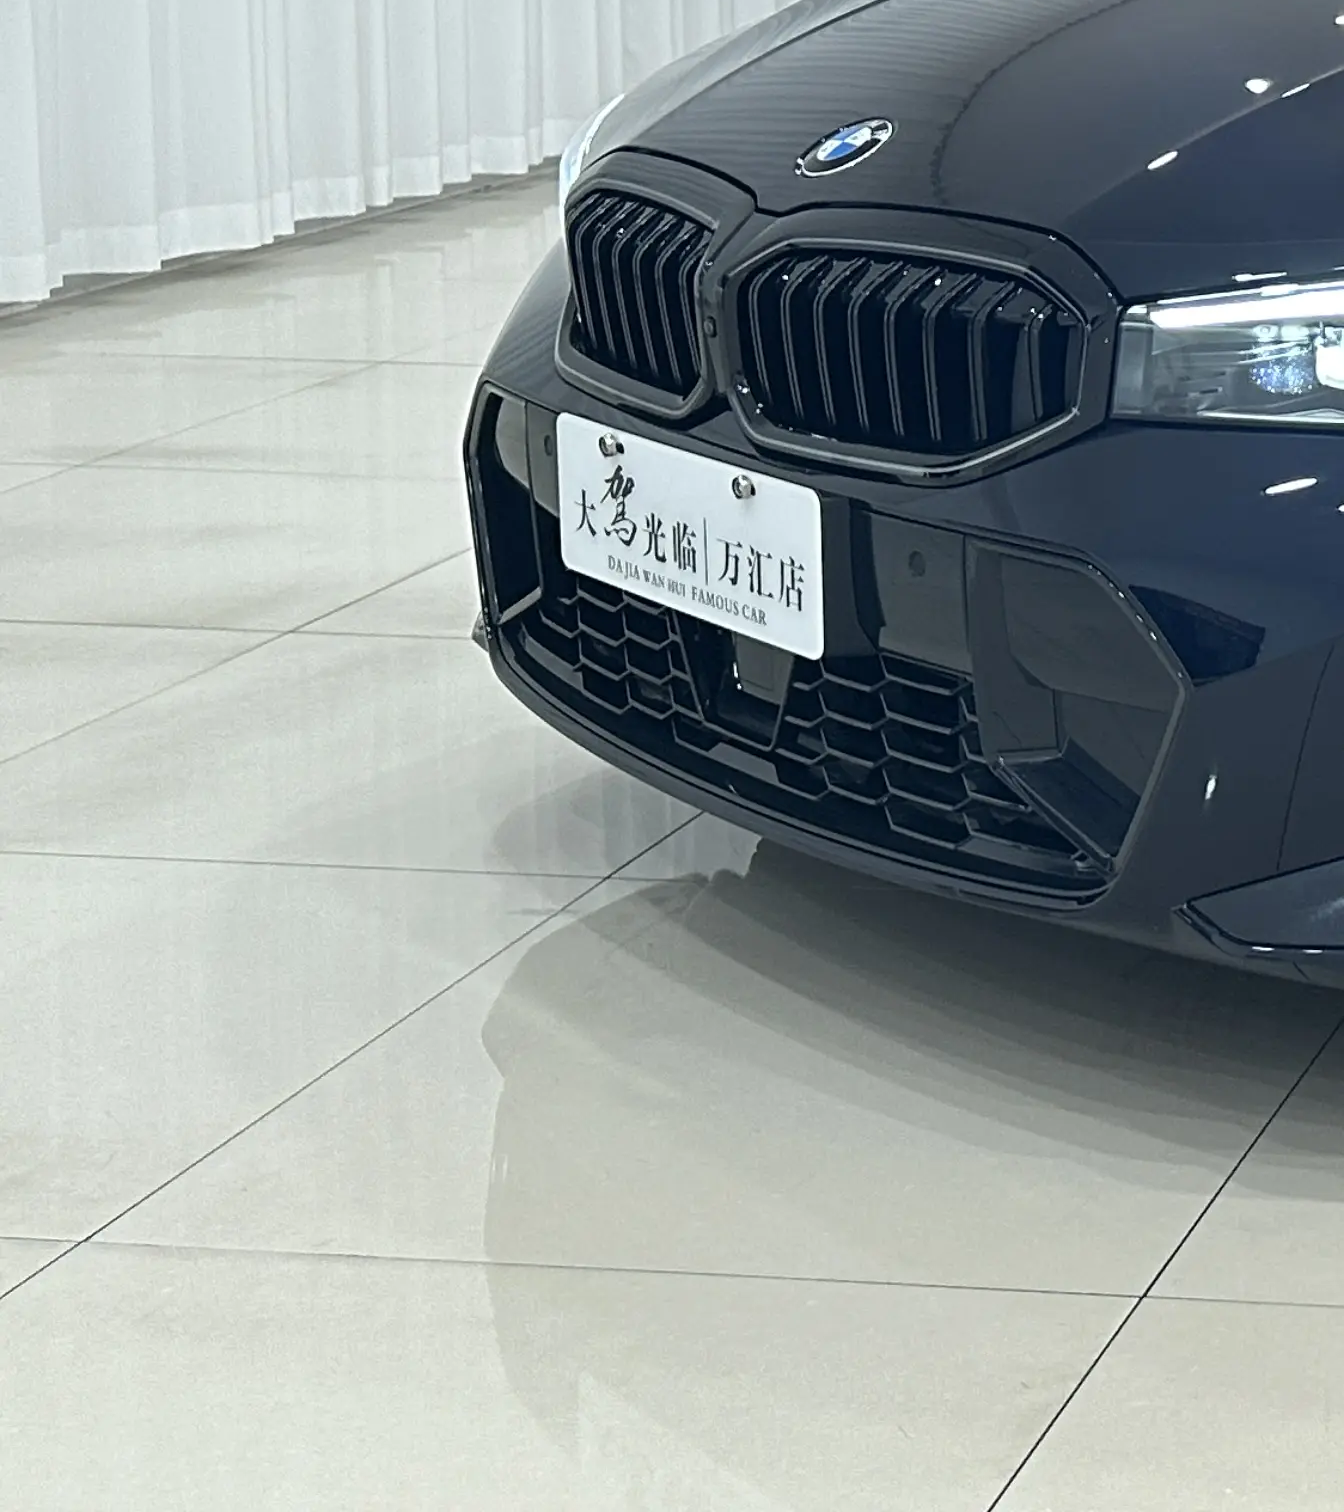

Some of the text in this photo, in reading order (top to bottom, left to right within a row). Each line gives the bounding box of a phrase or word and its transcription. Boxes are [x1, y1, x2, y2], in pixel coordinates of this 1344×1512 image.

[574, 465, 805, 612] 大驾光临 万汇店
[643, 569, 665, 589] WAN
[668, 578, 686, 597] HUI
[691, 586, 740, 616] FAMOUS
[742, 604, 767, 626] CAR
